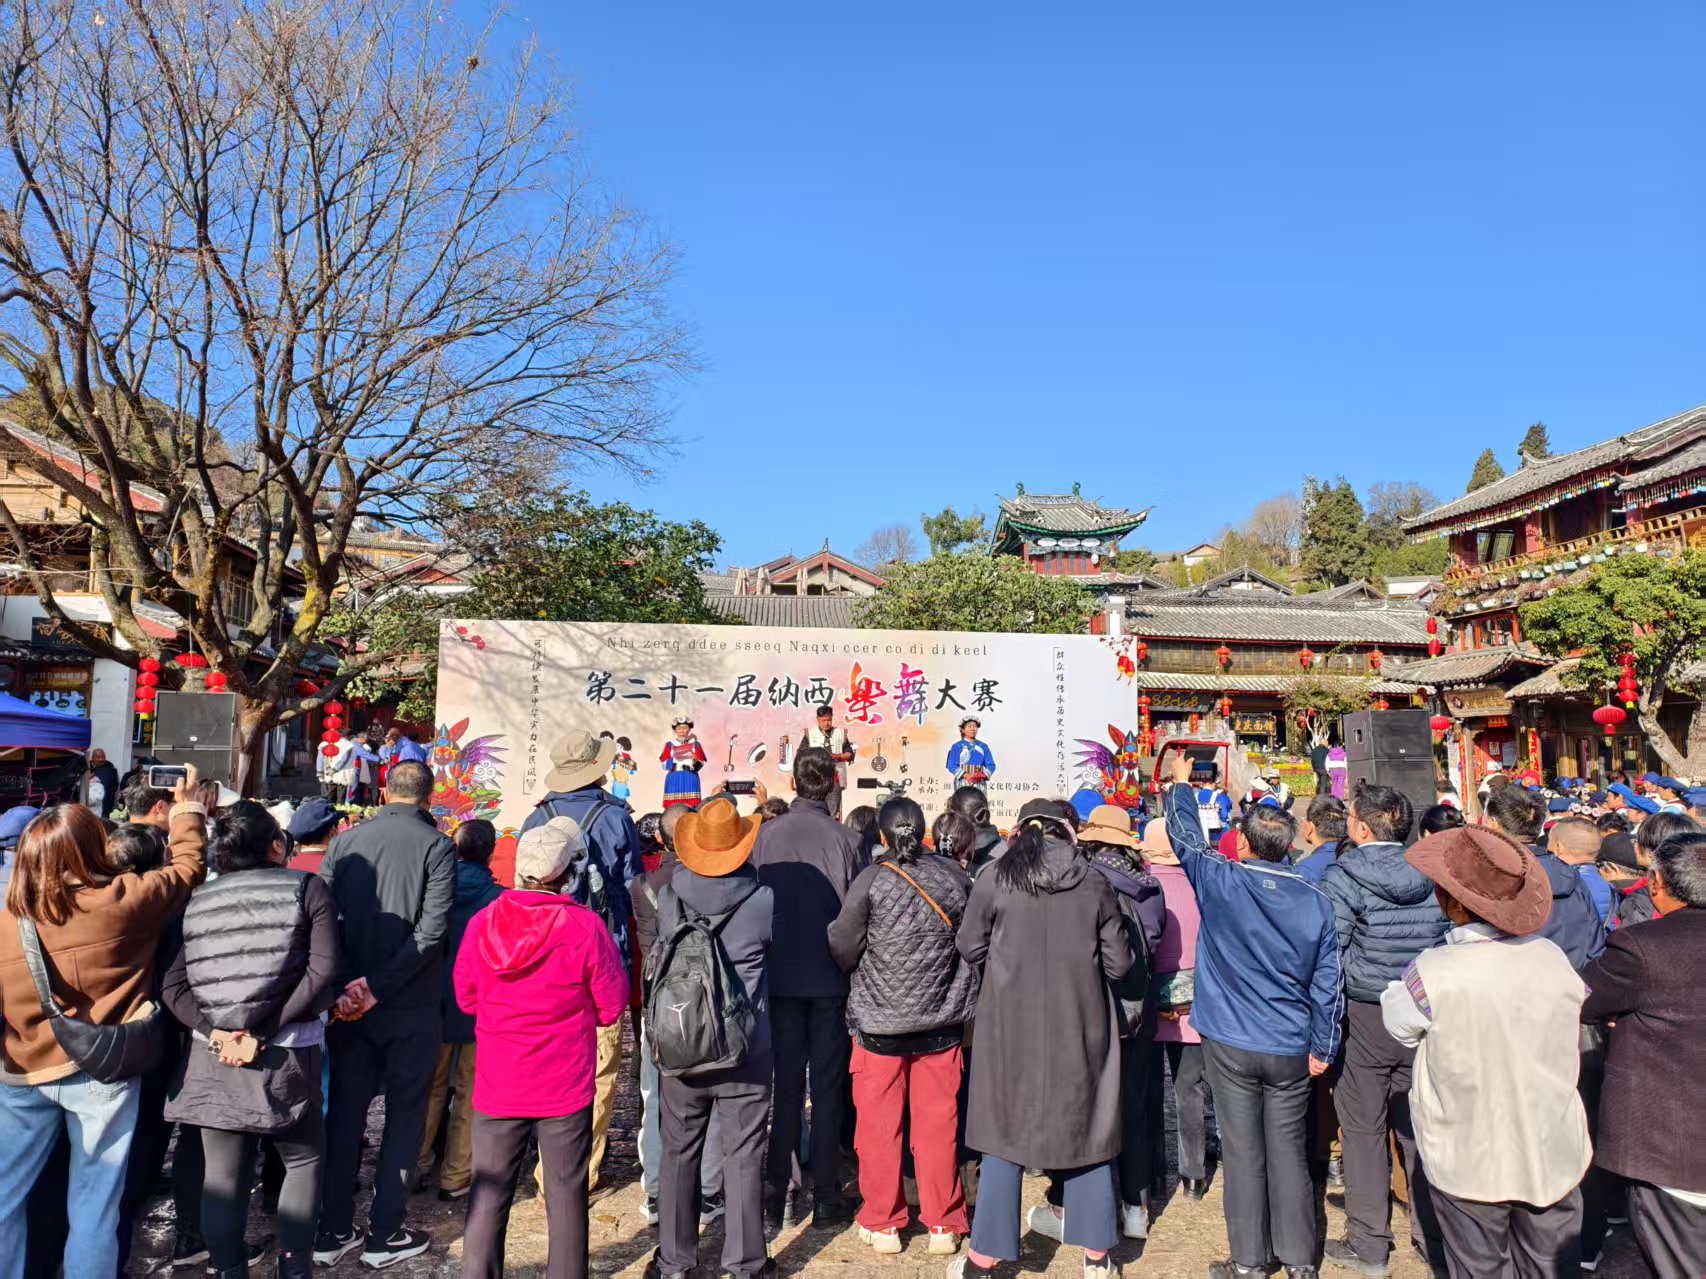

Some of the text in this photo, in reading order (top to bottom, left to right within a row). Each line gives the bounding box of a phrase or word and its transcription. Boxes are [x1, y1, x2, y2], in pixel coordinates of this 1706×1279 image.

[607, 637, 634, 649] Nhi
[643, 639, 680, 651] zerq
[688, 638, 727, 650] ddee
[735, 640, 782, 653] sseeq
[789, 640, 836, 656] Naqxi
[886, 644, 902, 654] co
[909, 643, 924, 655] di
[931, 643, 946, 655] di
[953, 644, 988, 656] keel
